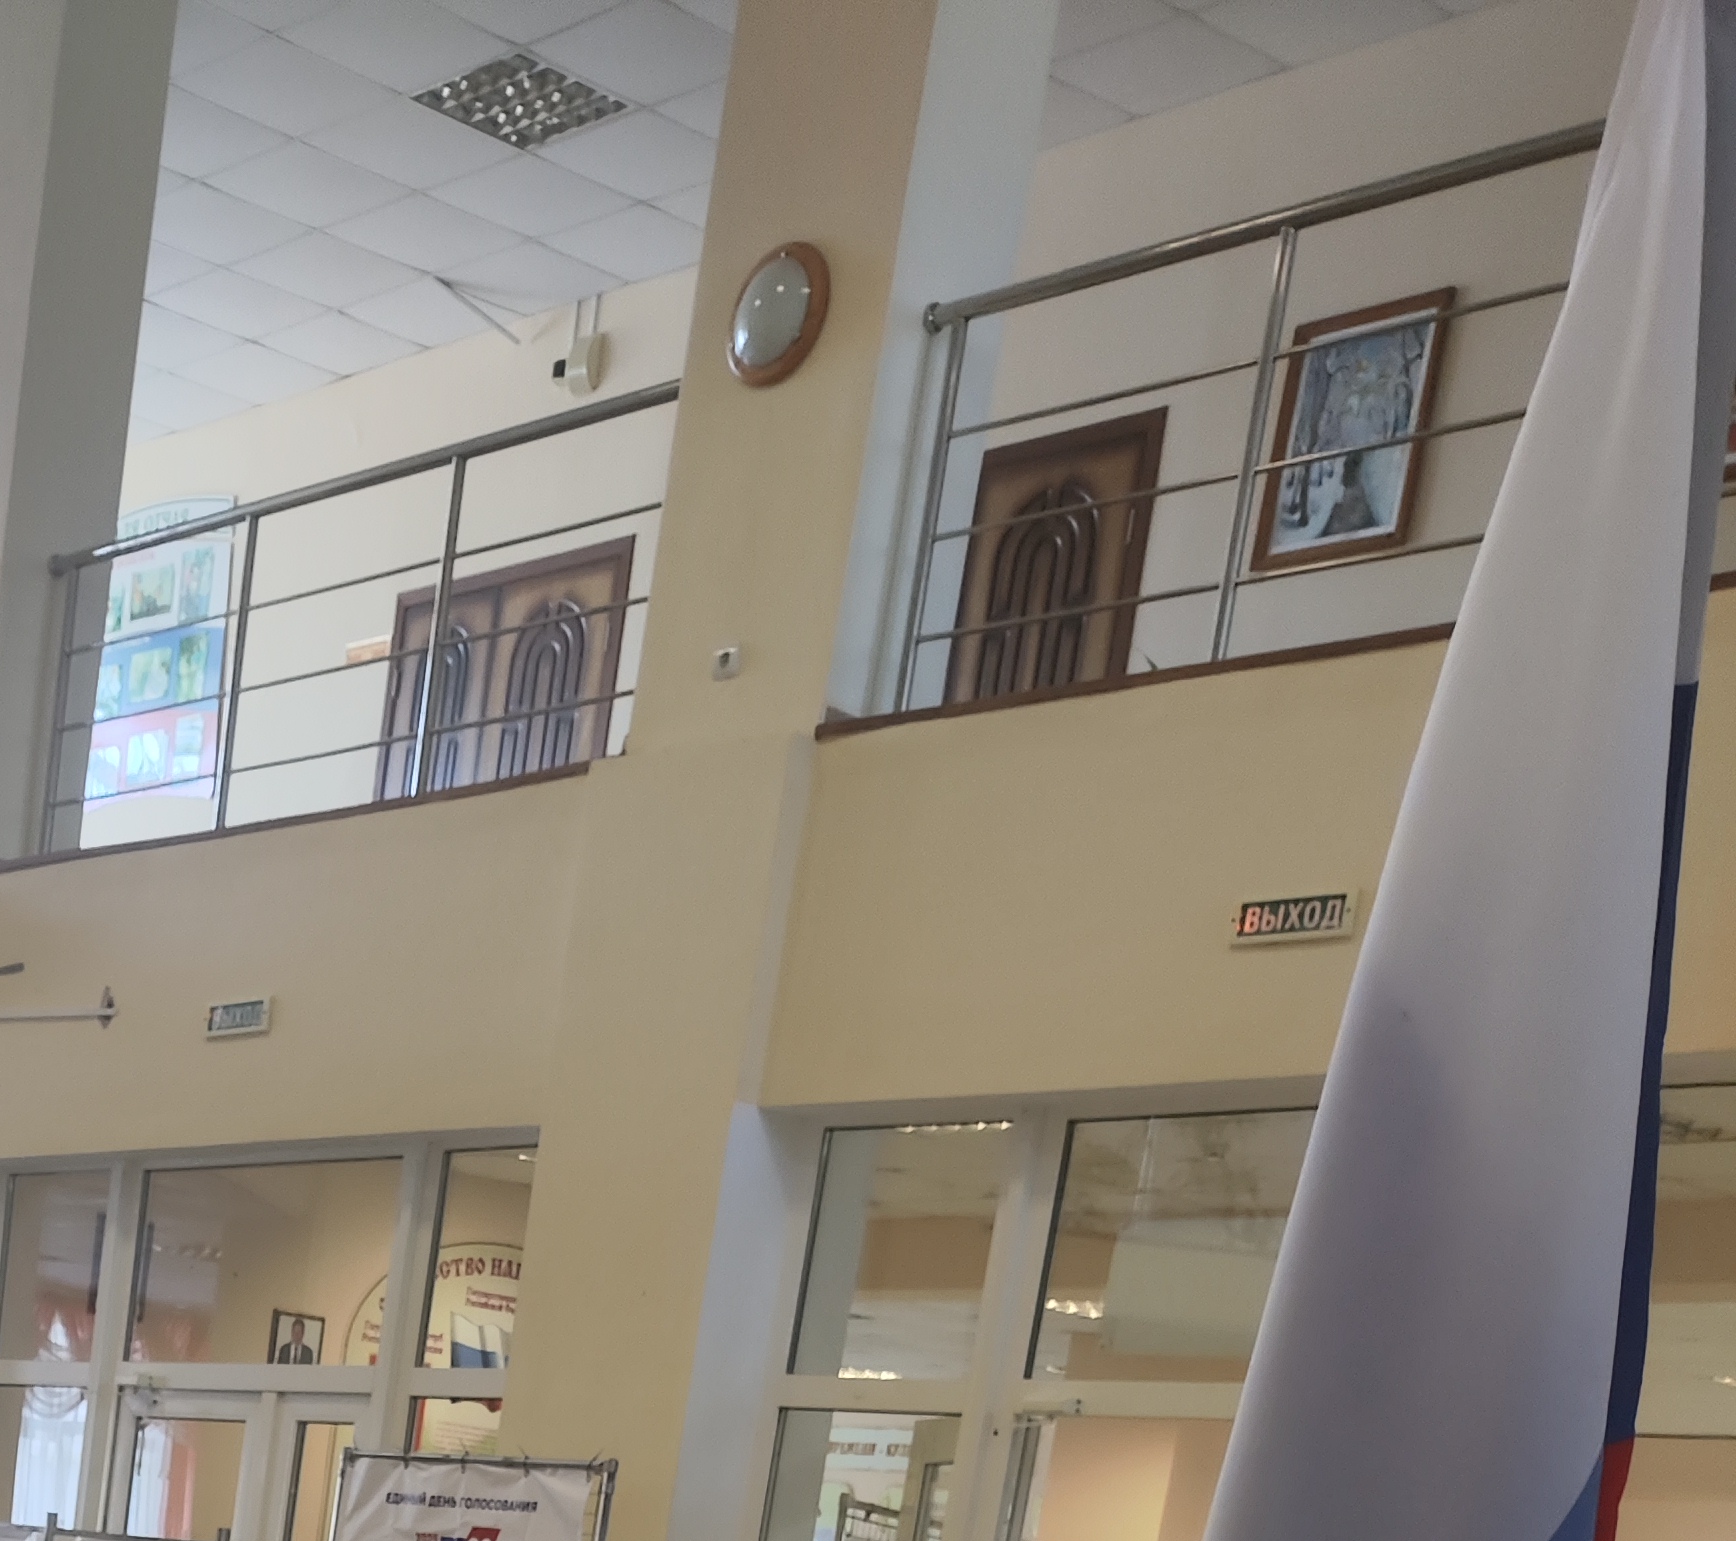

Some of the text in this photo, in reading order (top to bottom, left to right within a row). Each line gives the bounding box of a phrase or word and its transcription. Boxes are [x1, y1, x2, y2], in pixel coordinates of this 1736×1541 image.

[1244, 899, 1342, 934] ВЫХОД
[385, 1491, 538, 1513] ЕДИНЫЙ ДЕНЬ ГОЛОСОВАНИЯ
